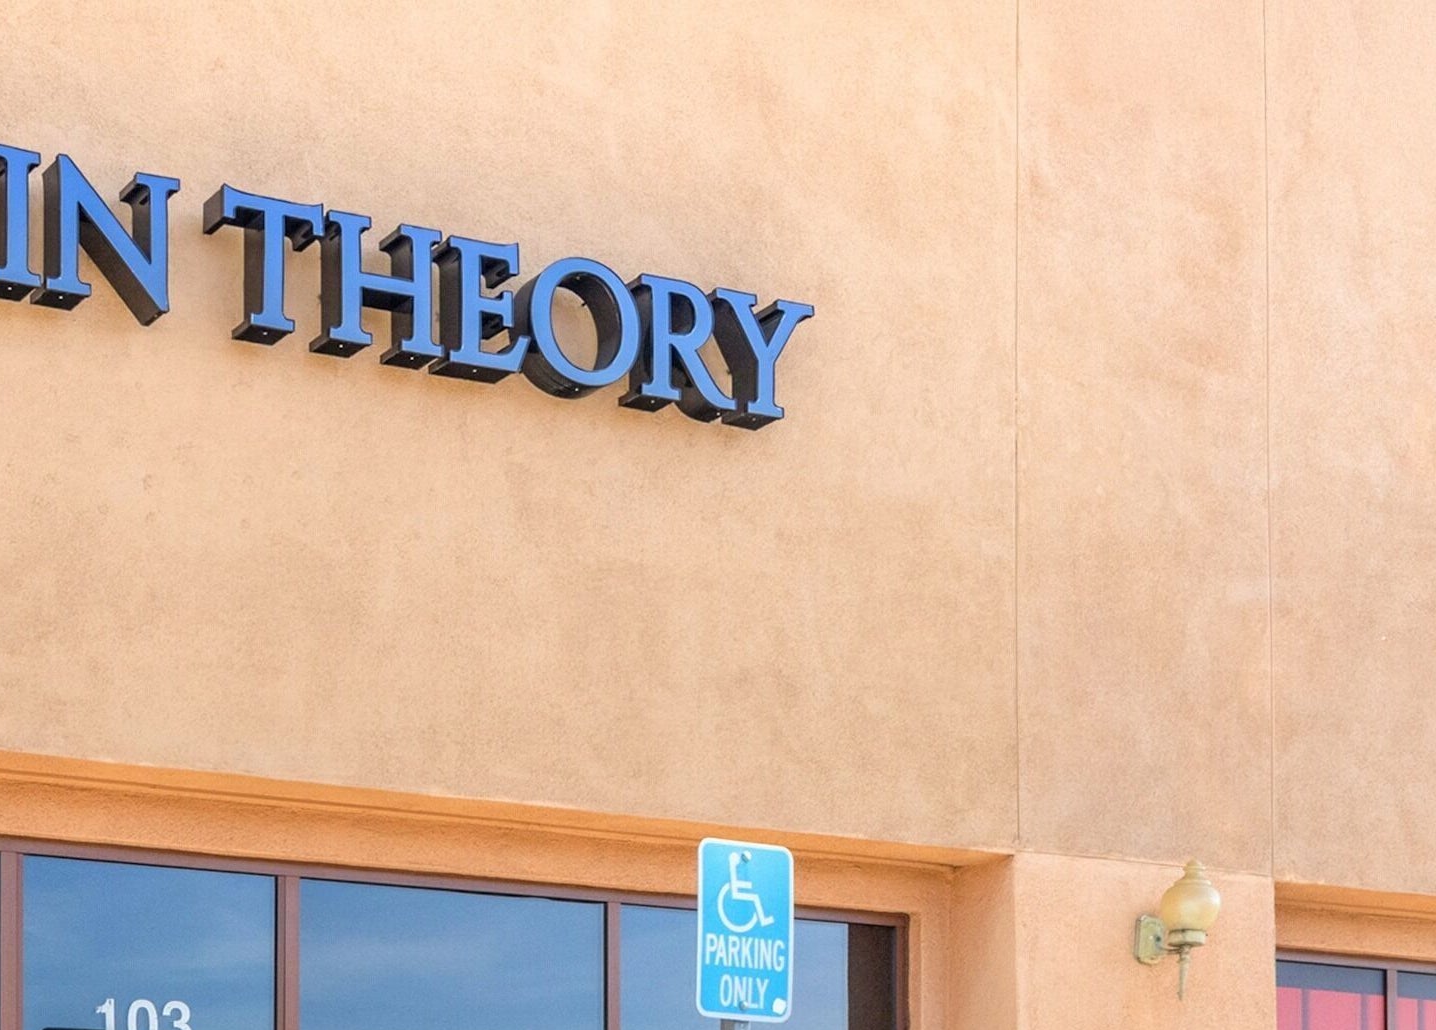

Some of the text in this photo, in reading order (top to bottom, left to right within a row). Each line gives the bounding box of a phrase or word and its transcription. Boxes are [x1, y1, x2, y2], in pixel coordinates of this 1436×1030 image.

[203, 184, 814, 430] THEORY
[705, 933, 785, 972] PARKING
[719, 973, 770, 1010] ONLY
